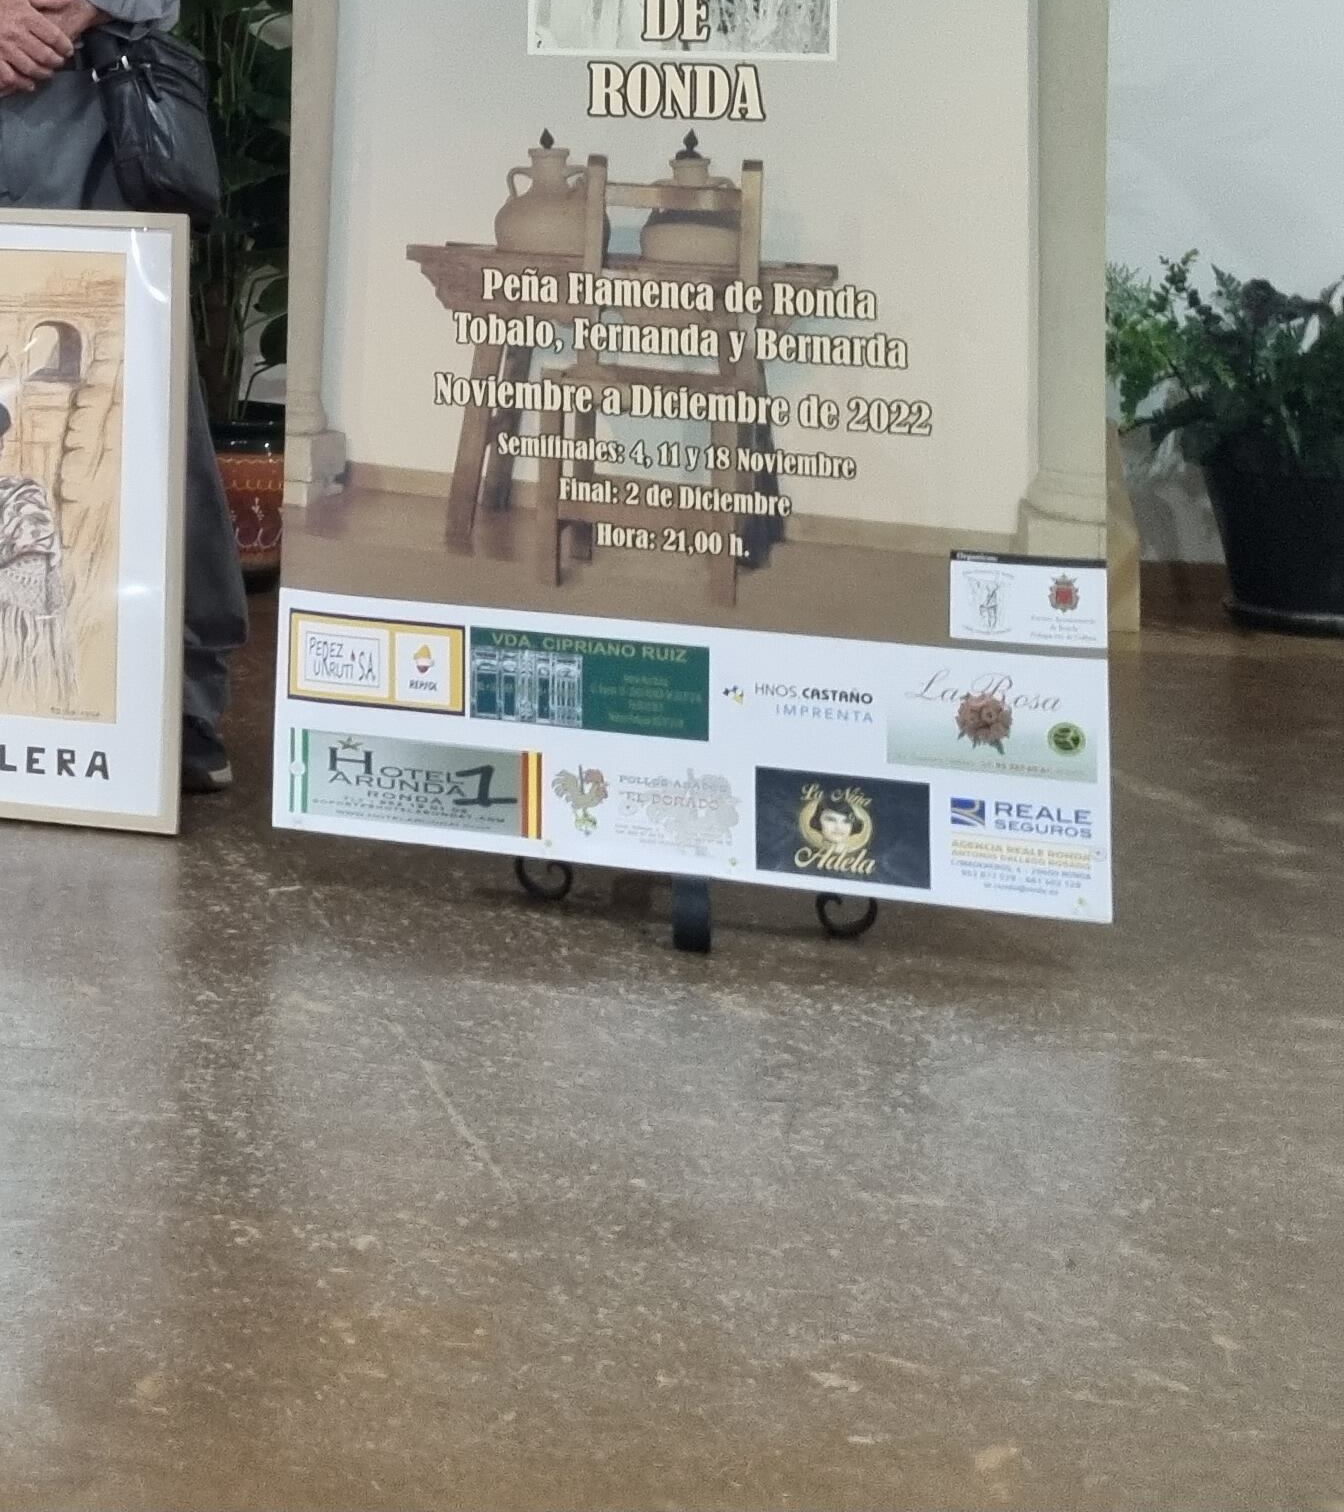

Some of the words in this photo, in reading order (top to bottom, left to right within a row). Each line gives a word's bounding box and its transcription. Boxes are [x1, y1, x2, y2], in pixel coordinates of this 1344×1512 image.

[587, 61, 767, 122] RONDA
[481, 267, 559, 303] Peña
[567, 272, 715, 313] Flamenca
[724, 280, 764, 314] de
[772, 282, 877, 320] Ronda
[452, 310, 564, 353] Tobalo,
[573, 317, 720, 358] Fernanda
[728, 329, 746, 363] y
[755, 326, 909, 370] Bernarda
[433, 371, 594, 414] Noviembre
[601, 385, 624, 417] a
[630, 383, 791, 428] Diciembre
[797, 393, 839, 430] de
[846, 396, 933, 437] 2022
[497, 431, 625, 464] Semifinales:
[629, 439, 652, 469] 4,
[657, 441, 680, 468] 11
[686, 445, 700, 471] y
[705, 444, 730, 471] 18
[736, 447, 857, 480] Noviembre
[558, 476, 619, 505] Final:
[625, 481, 640, 506] 2
[645, 482, 673, 509] de
[678, 485, 793, 517] Diciembre
[595, 521, 656, 550] Hora:
[662, 528, 723, 558] 21,00
[729, 531, 751, 558] h.
[491, 632, 531, 648] VDA
[542, 637, 636, 657] CIPRIANO
[642, 647, 688, 663] RUIZ
[802, 687, 873, 705] CASTAÑO
[905, 669, 959, 703] La
[971, 672, 1062, 712] Rosa
[776, 703, 873, 723] IMPRENTA
[328, 746, 464, 784] HOTEL
[453, 764, 518, 807] 1
[329, 771, 466, 797] ARUNDA
[367, 790, 443, 804] RONDA
[800, 782, 824, 801] La
[830, 787, 872, 807] Niña
[994, 800, 1093, 825] REALE
[994, 819, 1092, 839] SEGUROS
[794, 843, 876, 875] Adela
